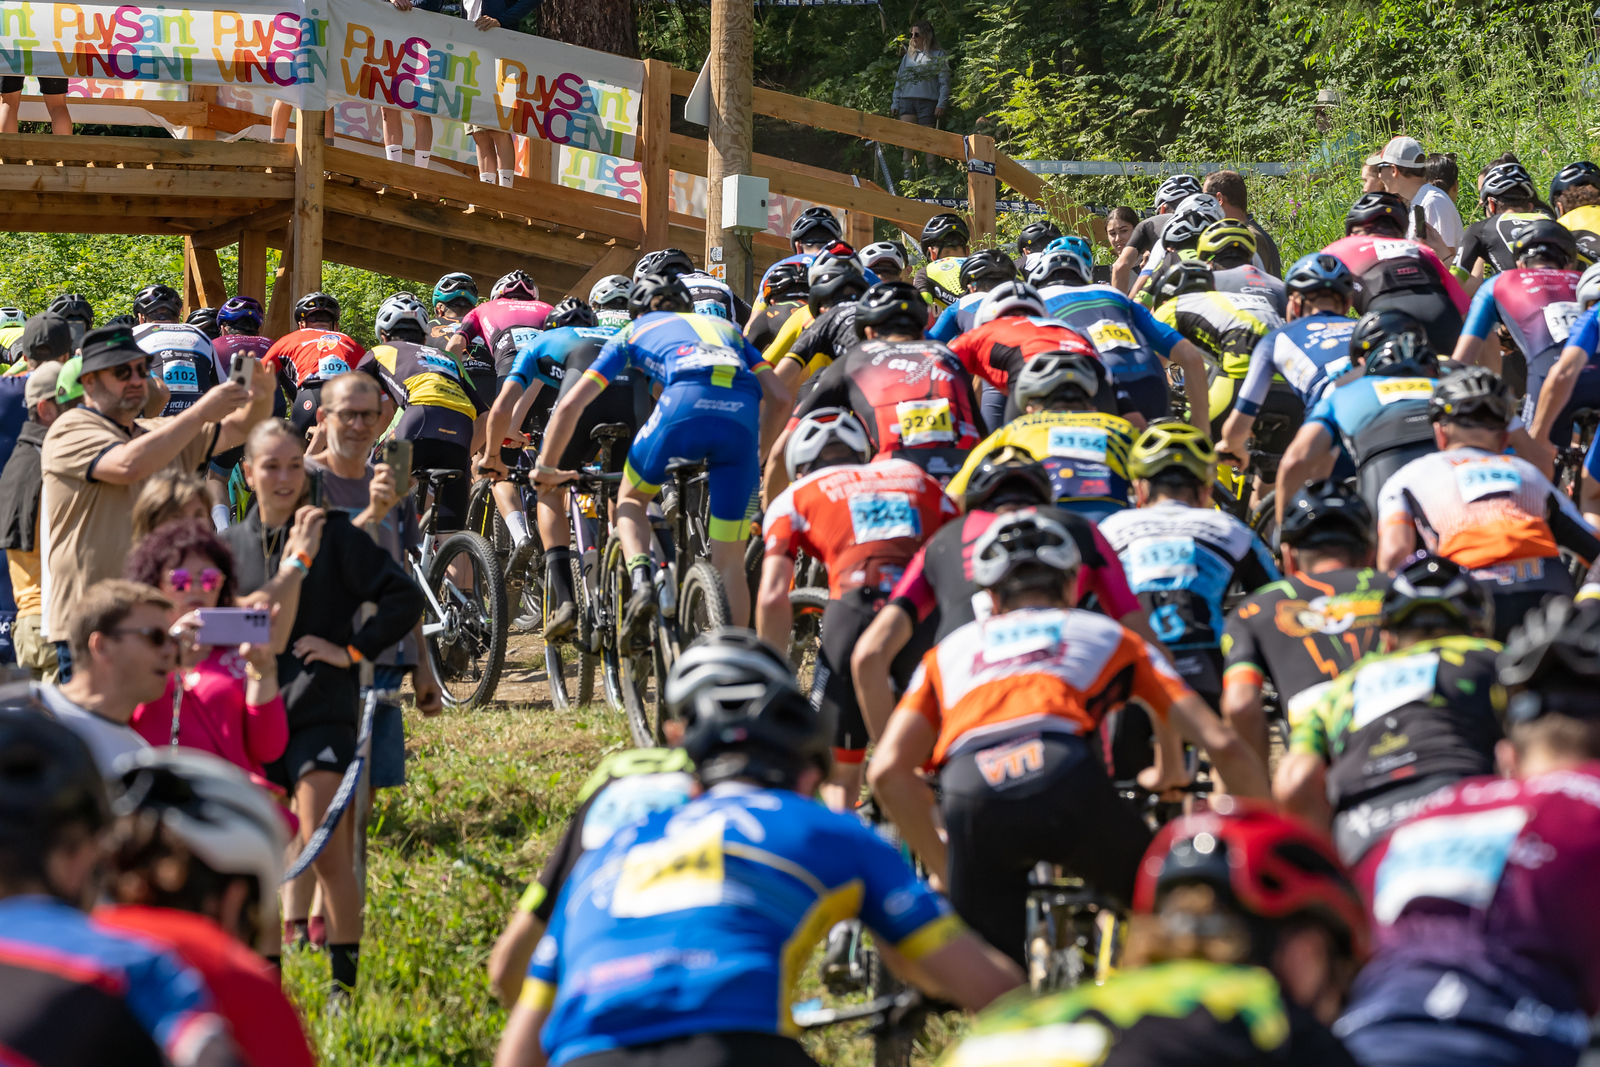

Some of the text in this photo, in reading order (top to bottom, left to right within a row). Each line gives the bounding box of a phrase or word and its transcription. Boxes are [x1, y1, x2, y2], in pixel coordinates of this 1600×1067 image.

[53, 40, 200, 82] VINCENT
[212, 46, 328, 87] VINCEN
[340, 58, 481, 122] VINCENT
[493, 93, 632, 156] VINCENT
[514, 333, 537, 342] 312
[165, 370, 196, 382] 3102
[321, 362, 349, 371] 3091
[903, 412, 947, 430] 3201
